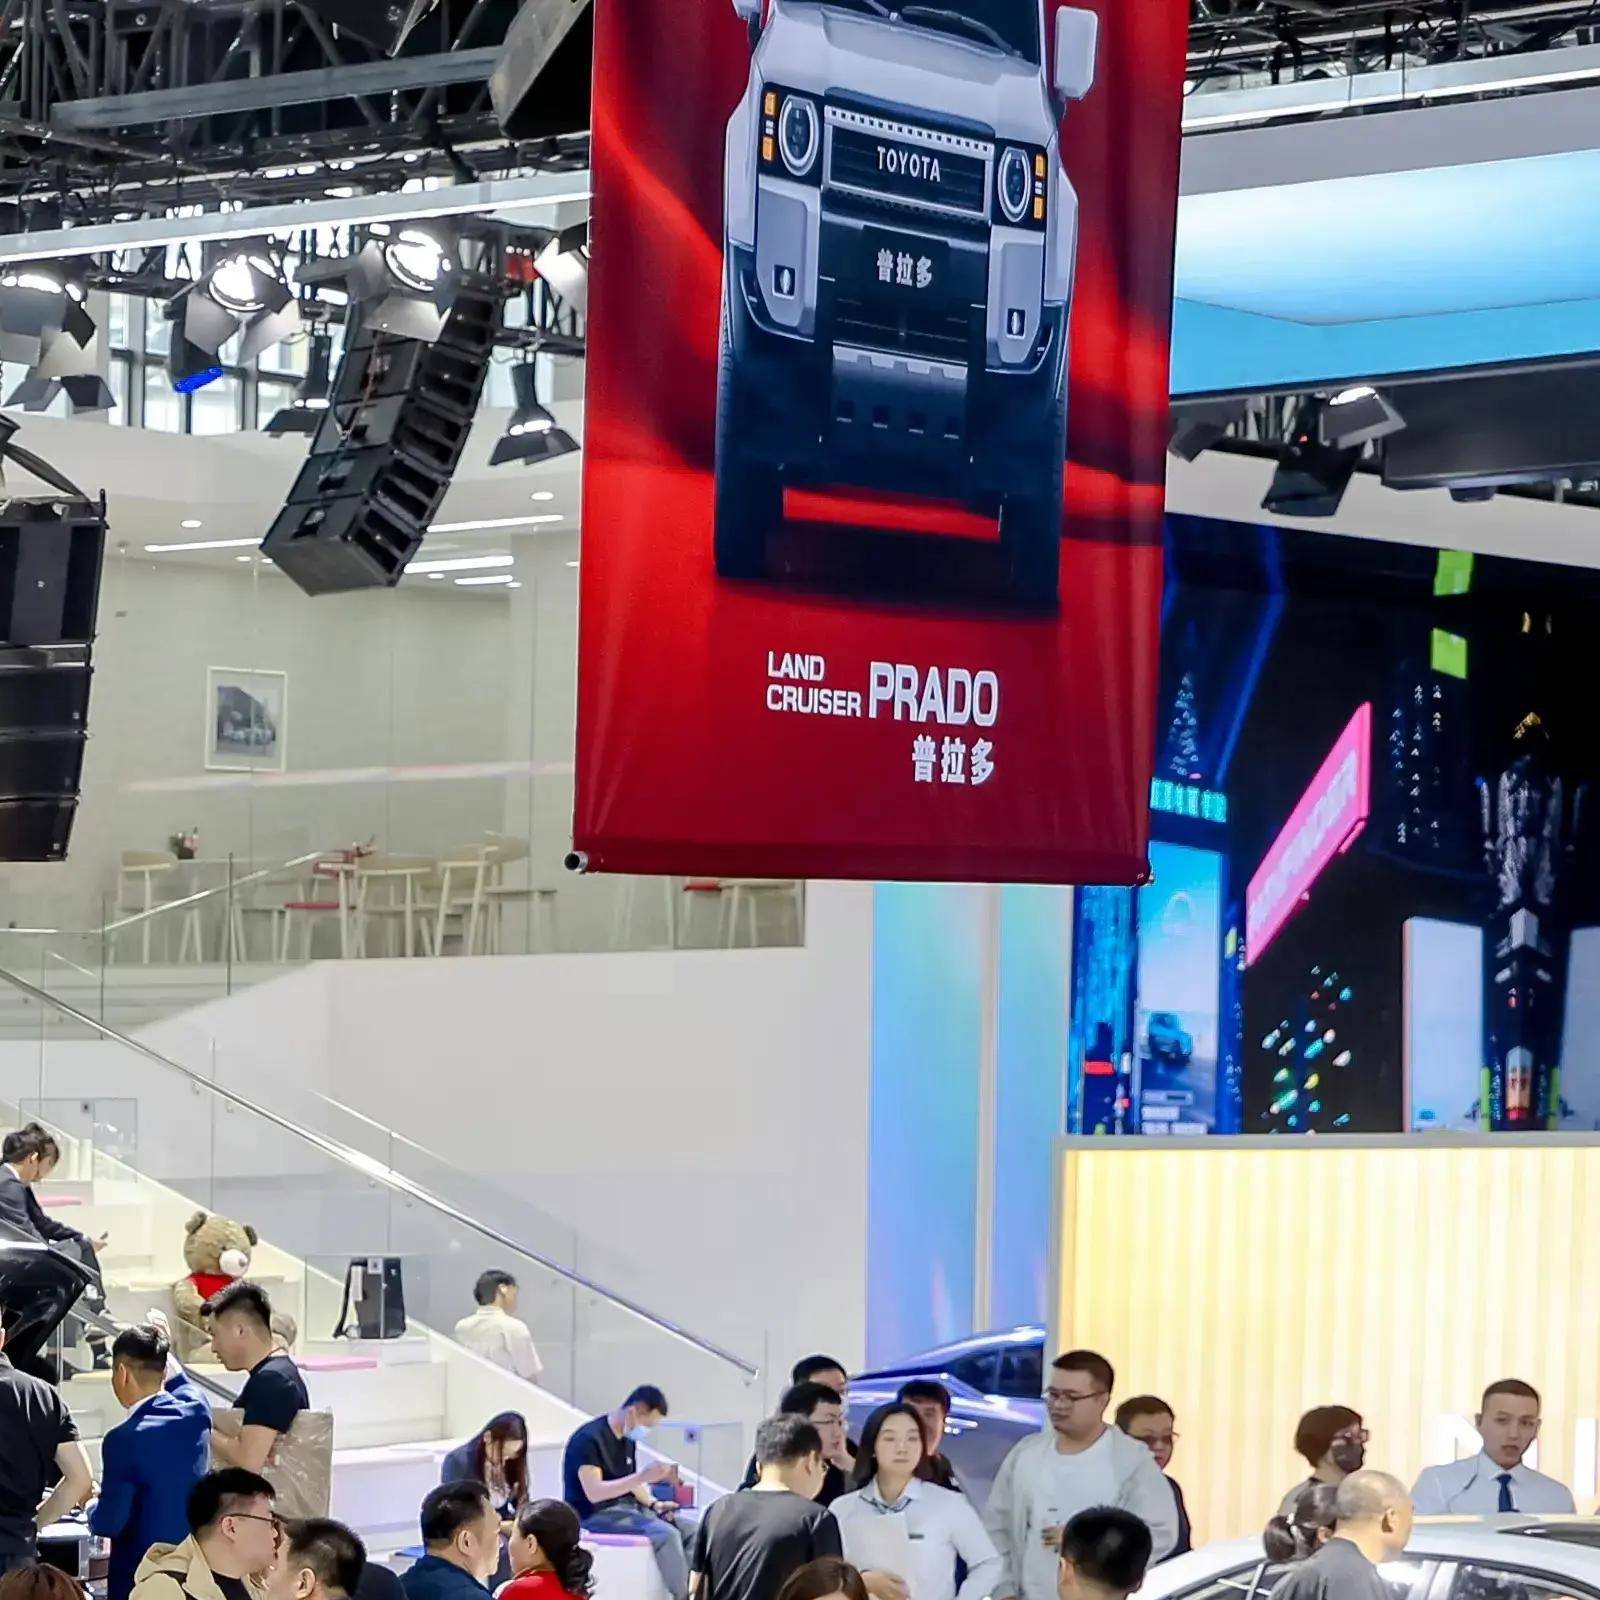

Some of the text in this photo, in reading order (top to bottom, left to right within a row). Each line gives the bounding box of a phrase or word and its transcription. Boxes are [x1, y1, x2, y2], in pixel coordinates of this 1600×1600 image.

[877, 146, 941, 182] TOYOTA
[877, 248, 932, 288] 普拉多
[767, 651, 825, 681] LAND
[766, 684, 861, 717] CRUISER
[868, 661, 998, 727] PRADO
[912, 734, 994, 785] 普拉多
